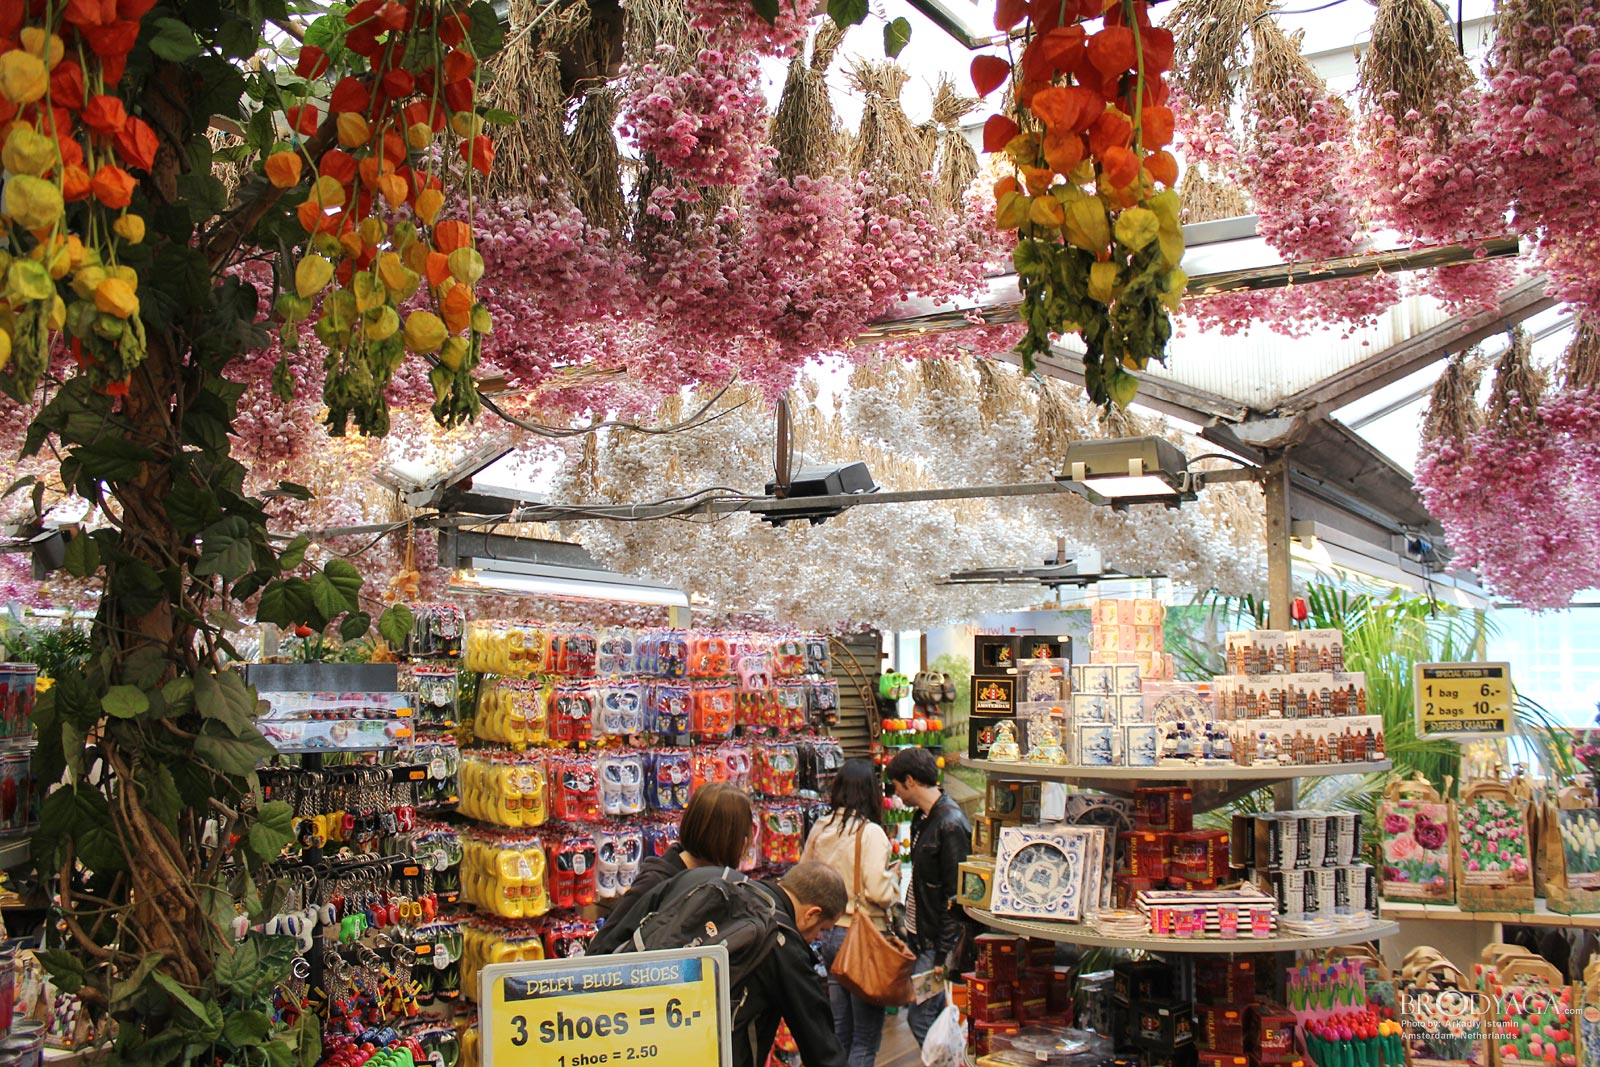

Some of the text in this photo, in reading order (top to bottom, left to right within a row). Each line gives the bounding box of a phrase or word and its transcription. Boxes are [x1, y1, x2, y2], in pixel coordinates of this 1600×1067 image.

[964, 624, 1004, 635] Nieuw!
[1426, 683, 1501, 700] 1 bag 6.-
[1426, 701, 1501, 718] 2 bags 10.-
[1463, 720, 1499, 731] QUALITY
[526, 965, 680, 996] DELFT BLUE SHOES
[510, 1015, 529, 1047] 3
[539, 1011, 629, 1044] shoes
[665, 997, 701, 1029] 6.-
[558, 1055, 566, 1067] 1
[571, 1051, 608, 1067] shoe
[626, 1044, 658, 1060] 2.50
